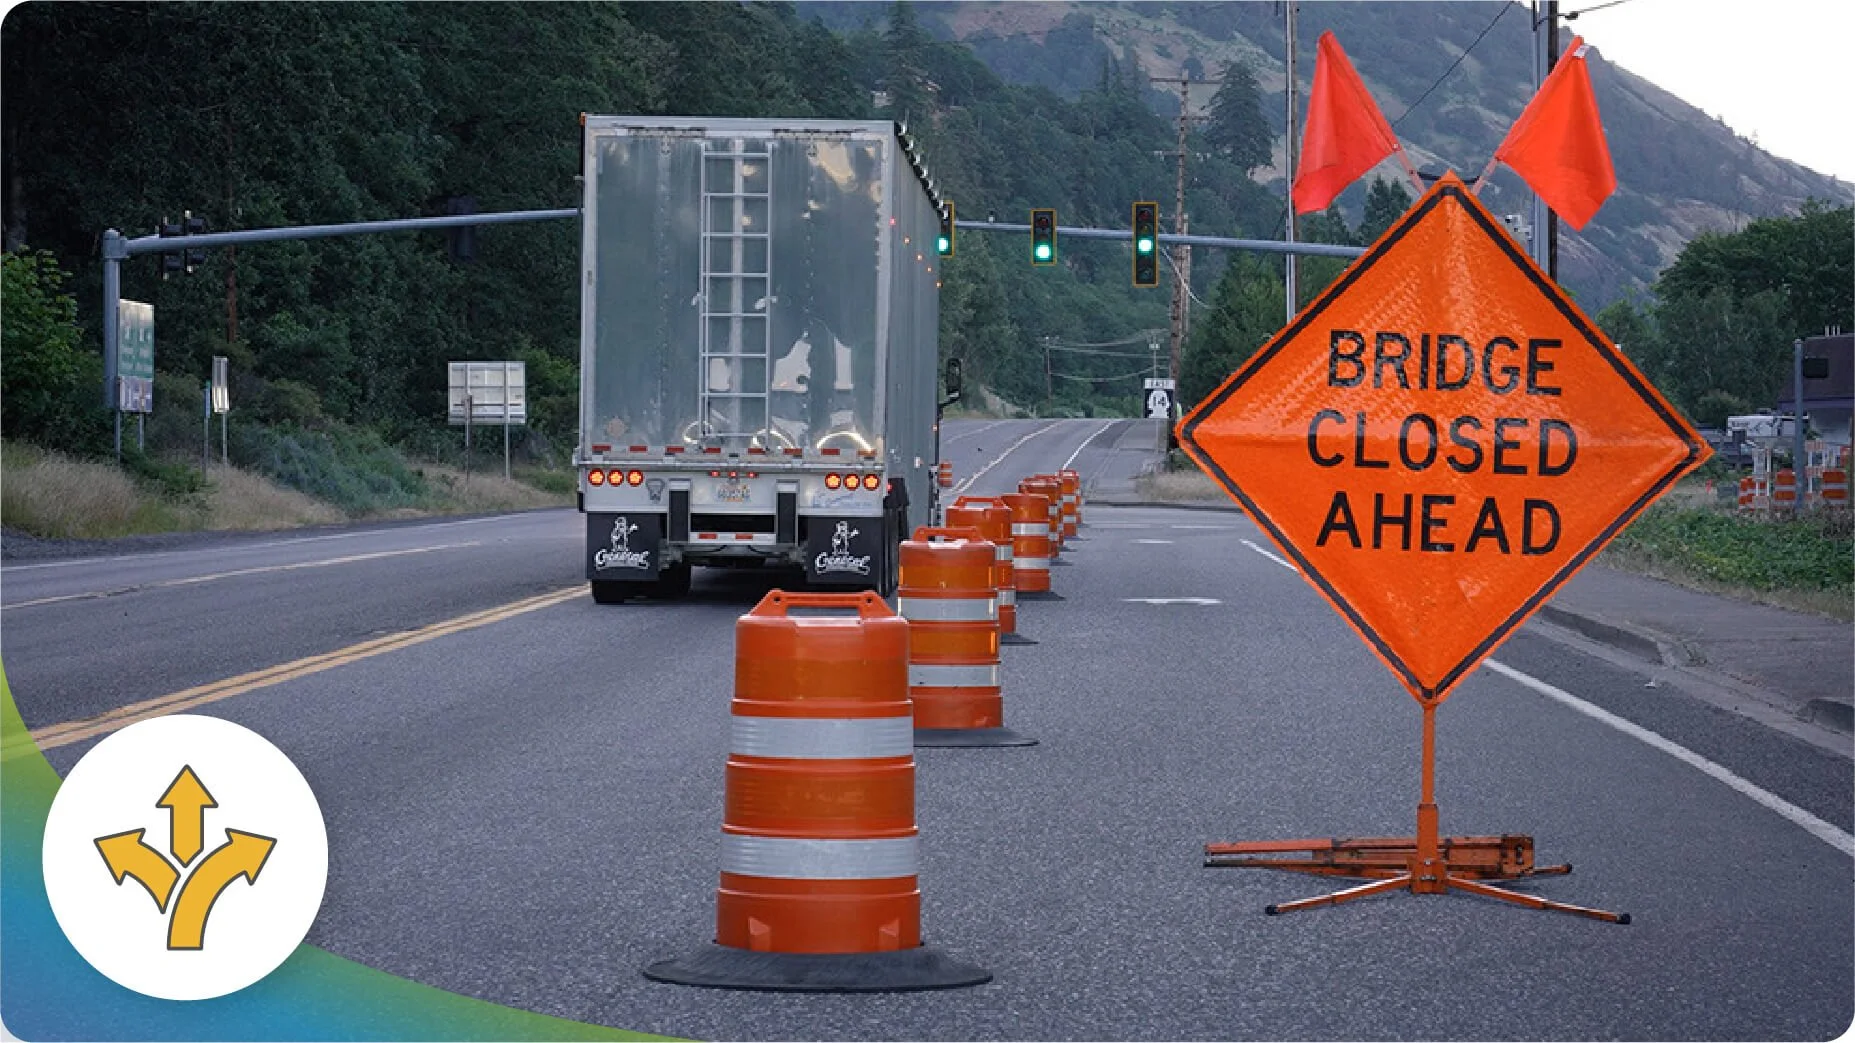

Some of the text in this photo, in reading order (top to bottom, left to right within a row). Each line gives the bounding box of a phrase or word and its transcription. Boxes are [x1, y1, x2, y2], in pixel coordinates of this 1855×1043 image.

[1328, 330, 1563, 396] BRIDGE
[1153, 396, 1167, 407] 14
[1307, 408, 1578, 477] CLOSED
[1315, 490, 1562, 556] AHEAD
